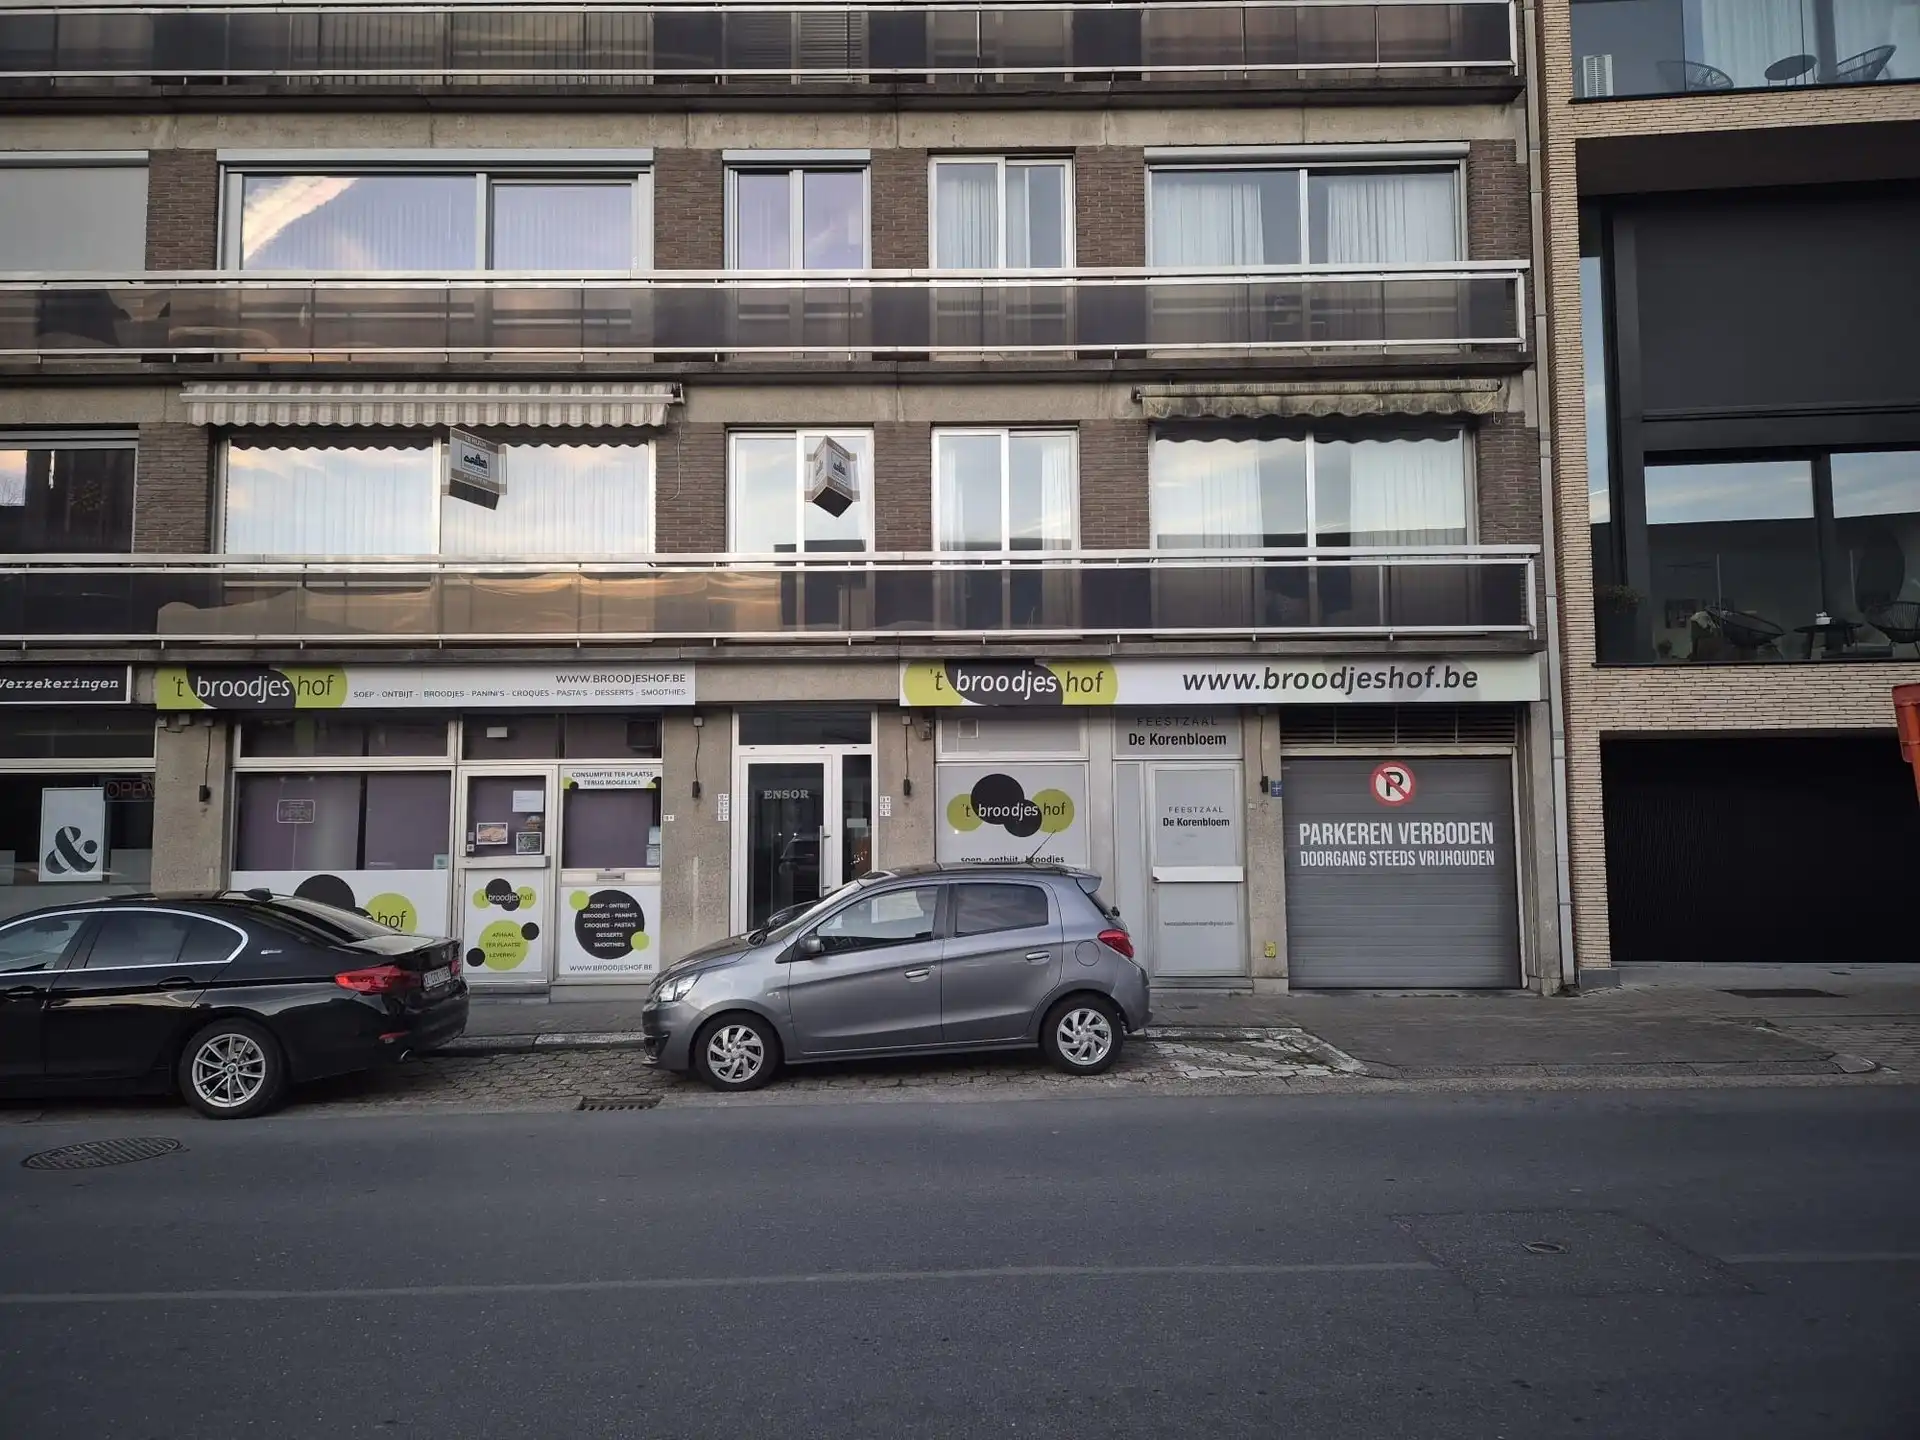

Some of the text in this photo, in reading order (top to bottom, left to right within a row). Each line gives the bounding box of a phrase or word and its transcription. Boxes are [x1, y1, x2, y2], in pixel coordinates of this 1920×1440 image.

[0, 678, 119, 691] Verzekeringen
[556, 673, 685, 684] WWW.BROODJESHOF.BE
[929, 668, 1104, 700] 't broodjes hof
[1182, 665, 1478, 695] www.broodjeshof.be
[172, 674, 334, 703] 't broodjes hof
[353, 690, 375, 698] SOEP
[381, 690, 413, 698] ONTBIJT
[423, 690, 465, 699] BROODJES
[511, 690, 550, 699] CROQUES
[556, 689, 588, 697] PASTA'S
[594, 688, 634, 697] DESSERTS
[640, 688, 686, 697] SMOOTHIES
[1137, 716, 1218, 727] FEESTZAAL
[1128, 732, 1227, 746] De Korenbloem
[763, 789, 809, 800] ENSOR
[978, 803, 1039, 821] broodjes
[1043, 802, 1066, 816] hof
[1162, 817, 1230, 827] De Korenbloem
[1300, 821, 1495, 845] PARKEREN VERBODEN
[1300, 850, 1495, 867] DOORGANG STEEDS VRIJHOUDEN
[377, 910, 408, 929] hof
[569, 964, 653, 972] WWW.BROODJESHOF.BE
